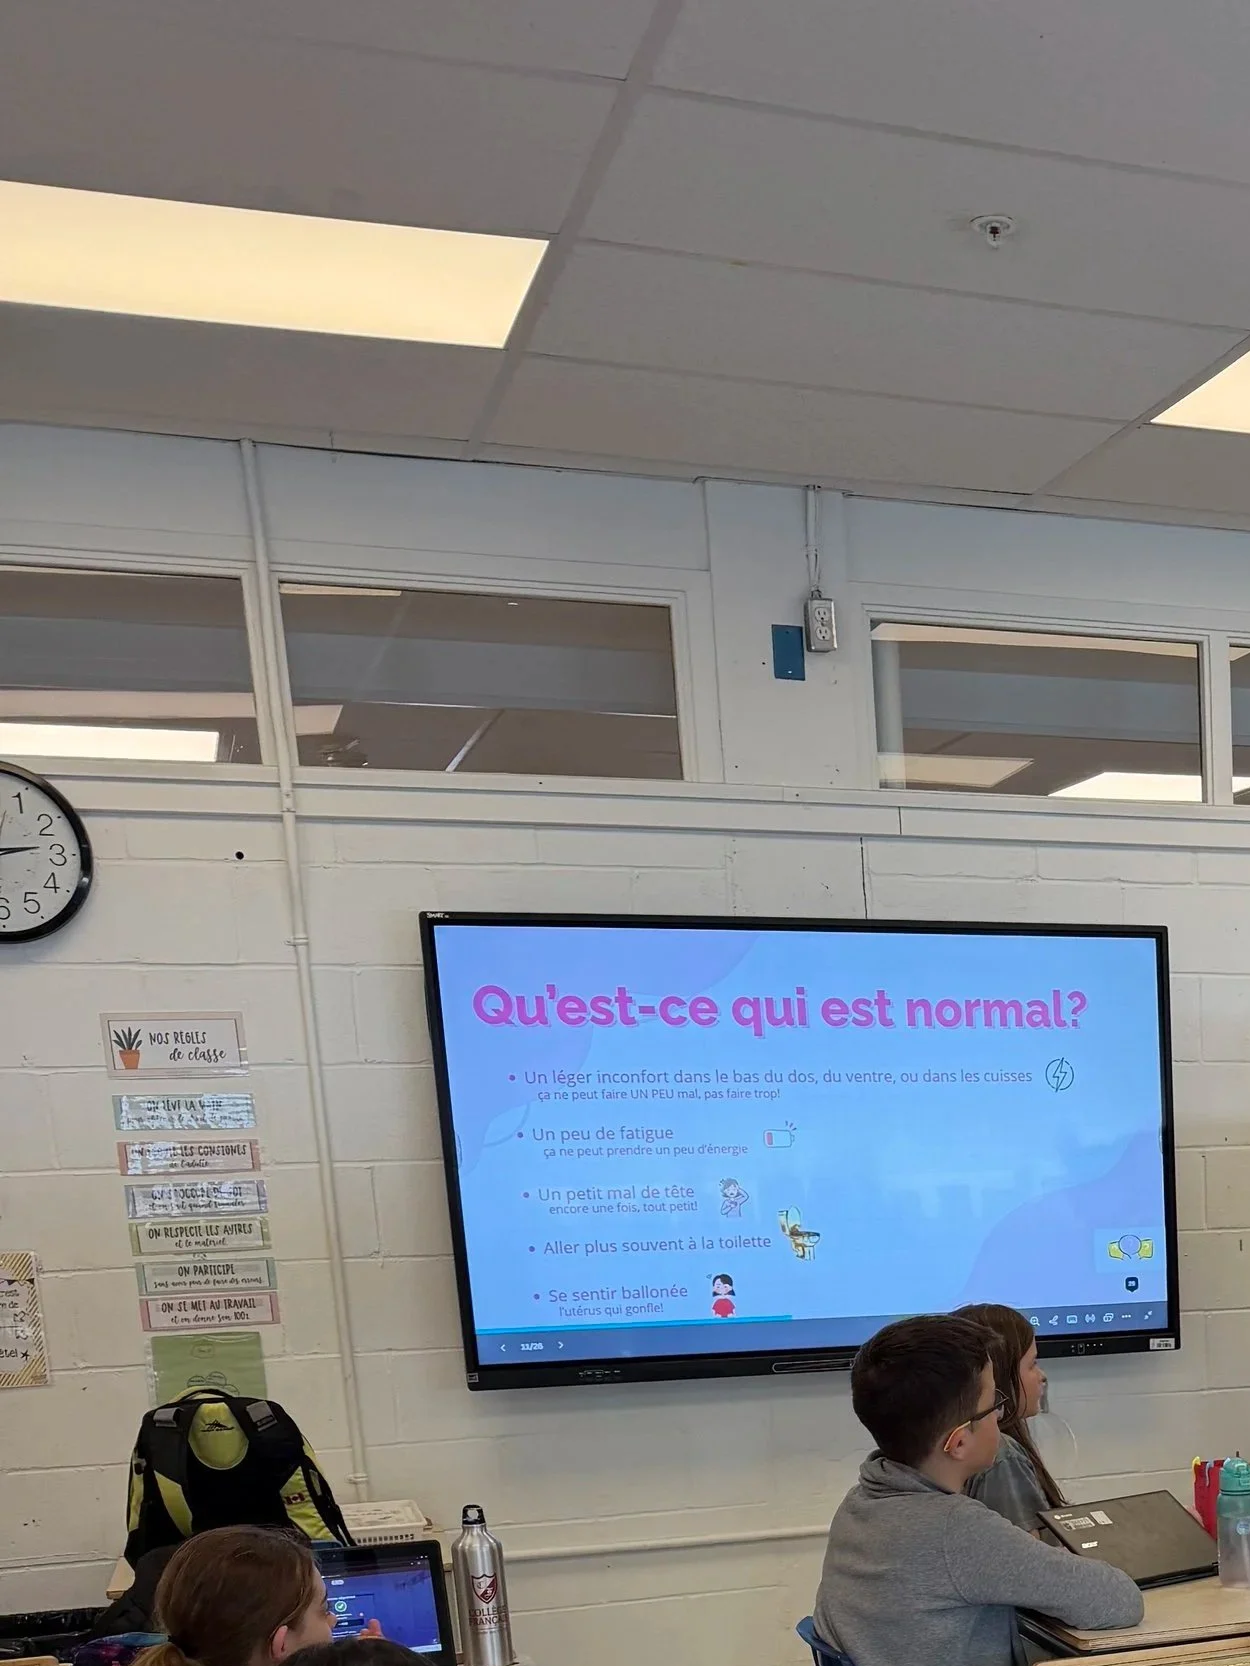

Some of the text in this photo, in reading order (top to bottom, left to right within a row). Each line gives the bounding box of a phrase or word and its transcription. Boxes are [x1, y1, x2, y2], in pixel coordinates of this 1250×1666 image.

[12, 792, 23, 814] 1
[37, 813, 55, 837] 2
[49, 843, 67, 867] 3
[43, 872, 60, 894] 4
[24, 892, 41, 914] 5
[472, 982, 1089, 1040] Qu'est-ce qui est normal?
[149, 1032, 170, 1045] NOS
[169, 1047, 227, 1063] de classe
[524, 1069, 1033, 1088] Un léger inconfort dans le bas du dos, du ventre, ou dans les cuisses
[537, 1090, 551, 1101] ça
[572, 1090, 599, 1101] peut
[601, 1088, 627, 1099] faire
[630, 1089, 648, 1099] UN
[651, 1089, 674, 1099] PEU
[677, 1088, 701, 1100] mal,
[704, 1090, 723, 1101] pas
[726, 1088, 751, 1099] faire
[754, 1088, 781, 1100] trop!
[532, 1125, 674, 1144] Un peu de fatigue
[543, 1147, 556, 1158] ça
[577, 1146, 603, 1158] peut
[606, 1144, 651, 1157] prendre
[655, 1146, 670, 1155] un
[673, 1146, 694, 1157] peu
[538, 1184, 695, 1204] Un petit mal de tête
[549, 1201, 698, 1215] encore une fois, tout petit!
[149, 1228, 161, 1239] ON
[164, 1225, 203, 1238] RESPECTE
[206, 1224, 219, 1236] LES
[544, 1235, 771, 1256] Aller plus souvent à la toilette
[178, 1263, 235, 1277] ON PARTICIPE
[549, 1284, 688, 1303] Se sentir ballonée
[161, 1298, 256, 1314] ON SE MET AU TRAVAIL
[559, 1303, 664, 1317] l'utérus qui gonfle!
